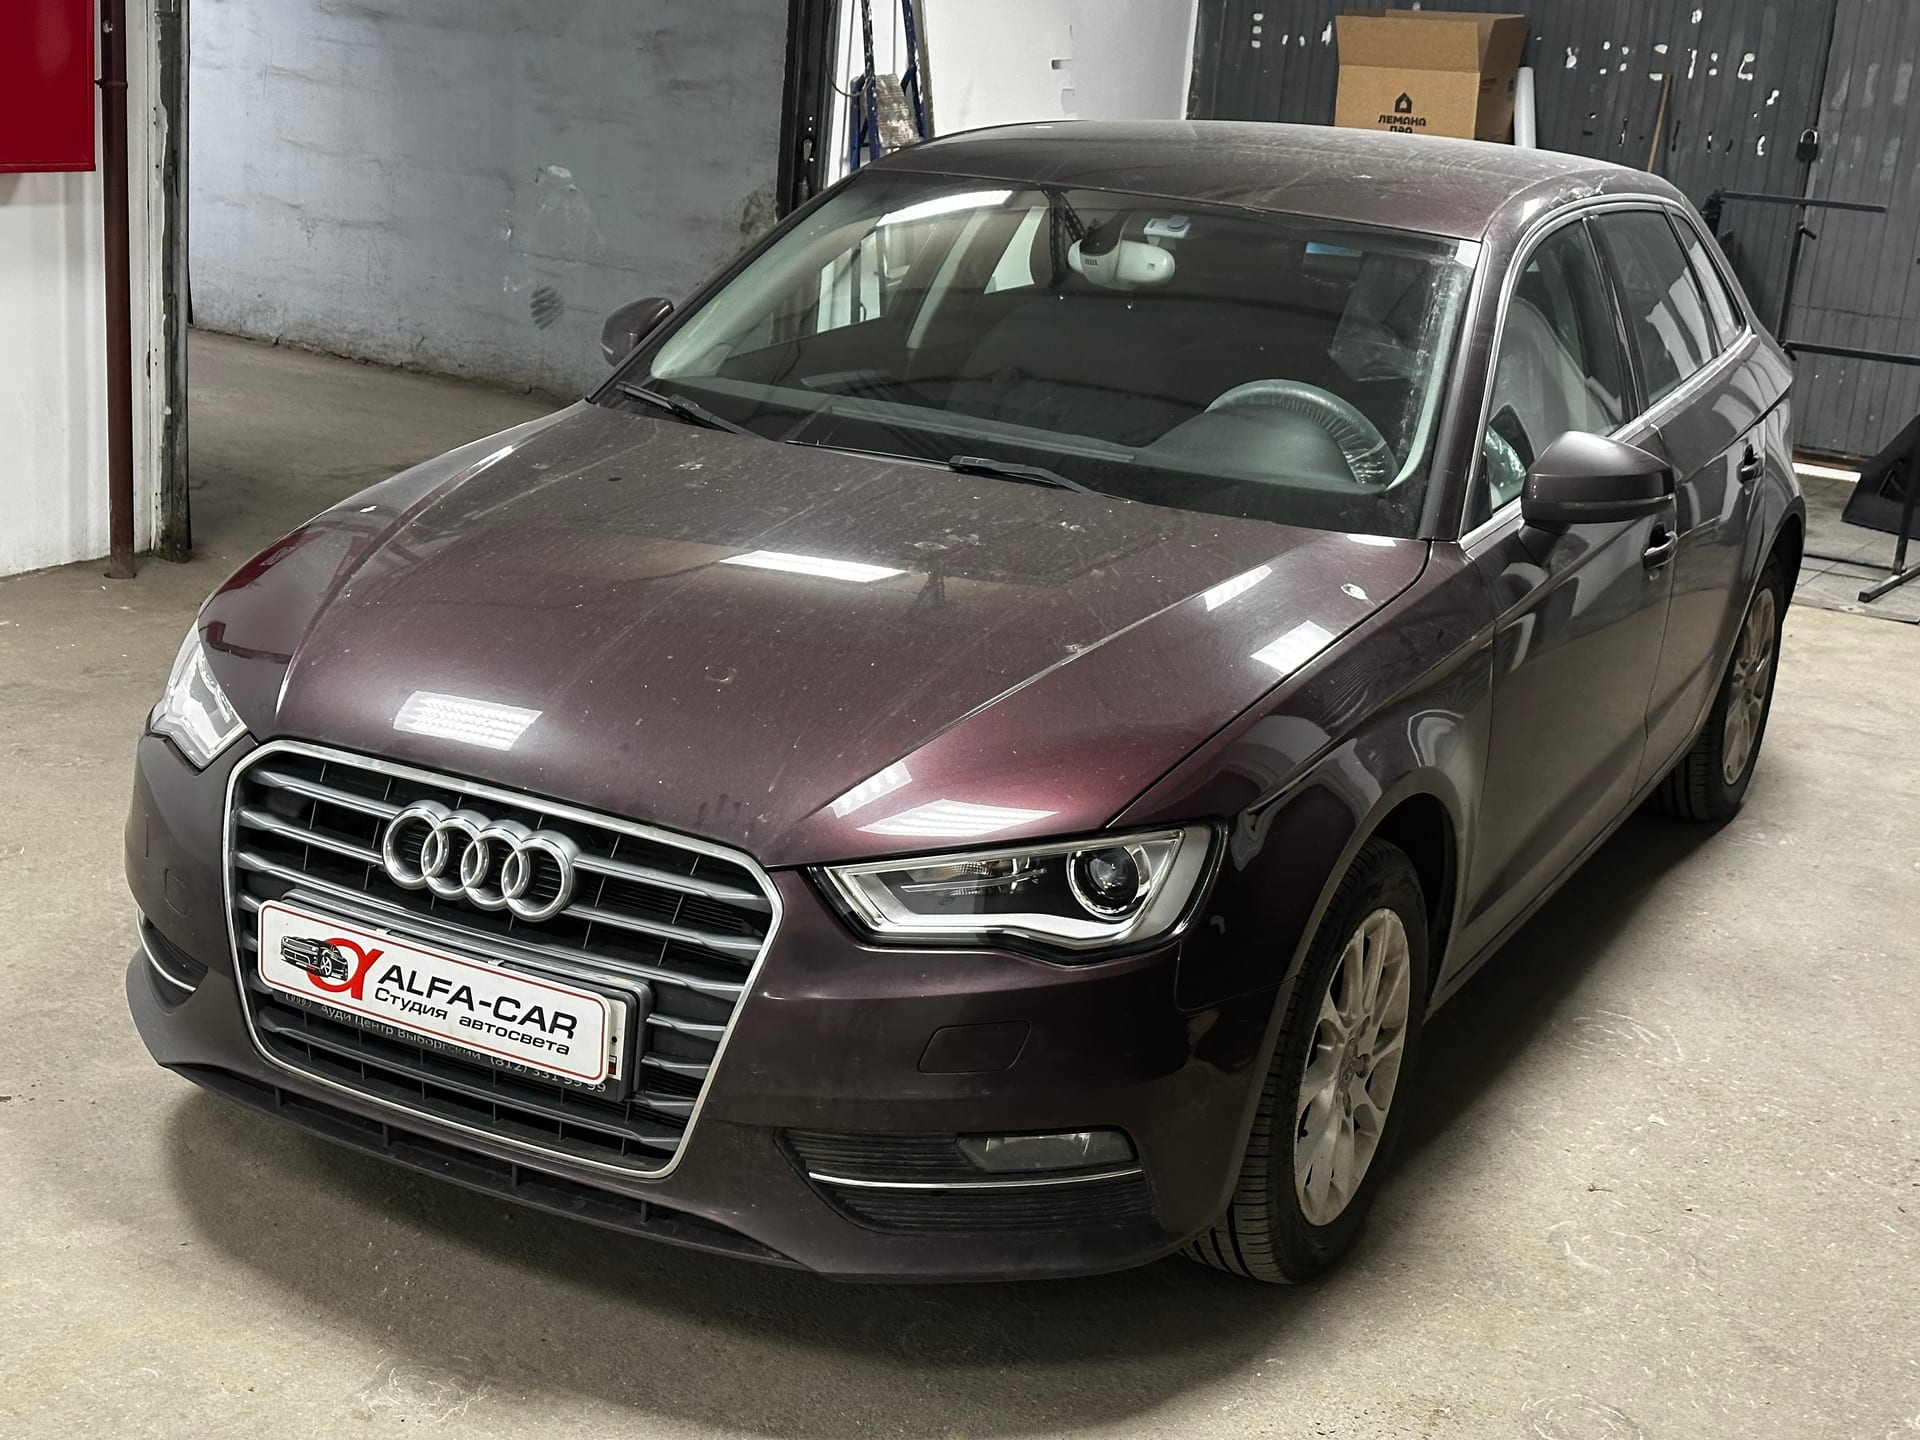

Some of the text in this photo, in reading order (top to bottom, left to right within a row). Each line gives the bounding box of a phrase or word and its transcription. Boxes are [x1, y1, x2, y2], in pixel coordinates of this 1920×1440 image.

[1378, 114, 1426, 127] ЛЕМАНА
[374, 987, 570, 1055] Студия автосвета
[377, 964, 578, 1040] ALFA-CAR
[355, 1015, 394, 1036] Центр
